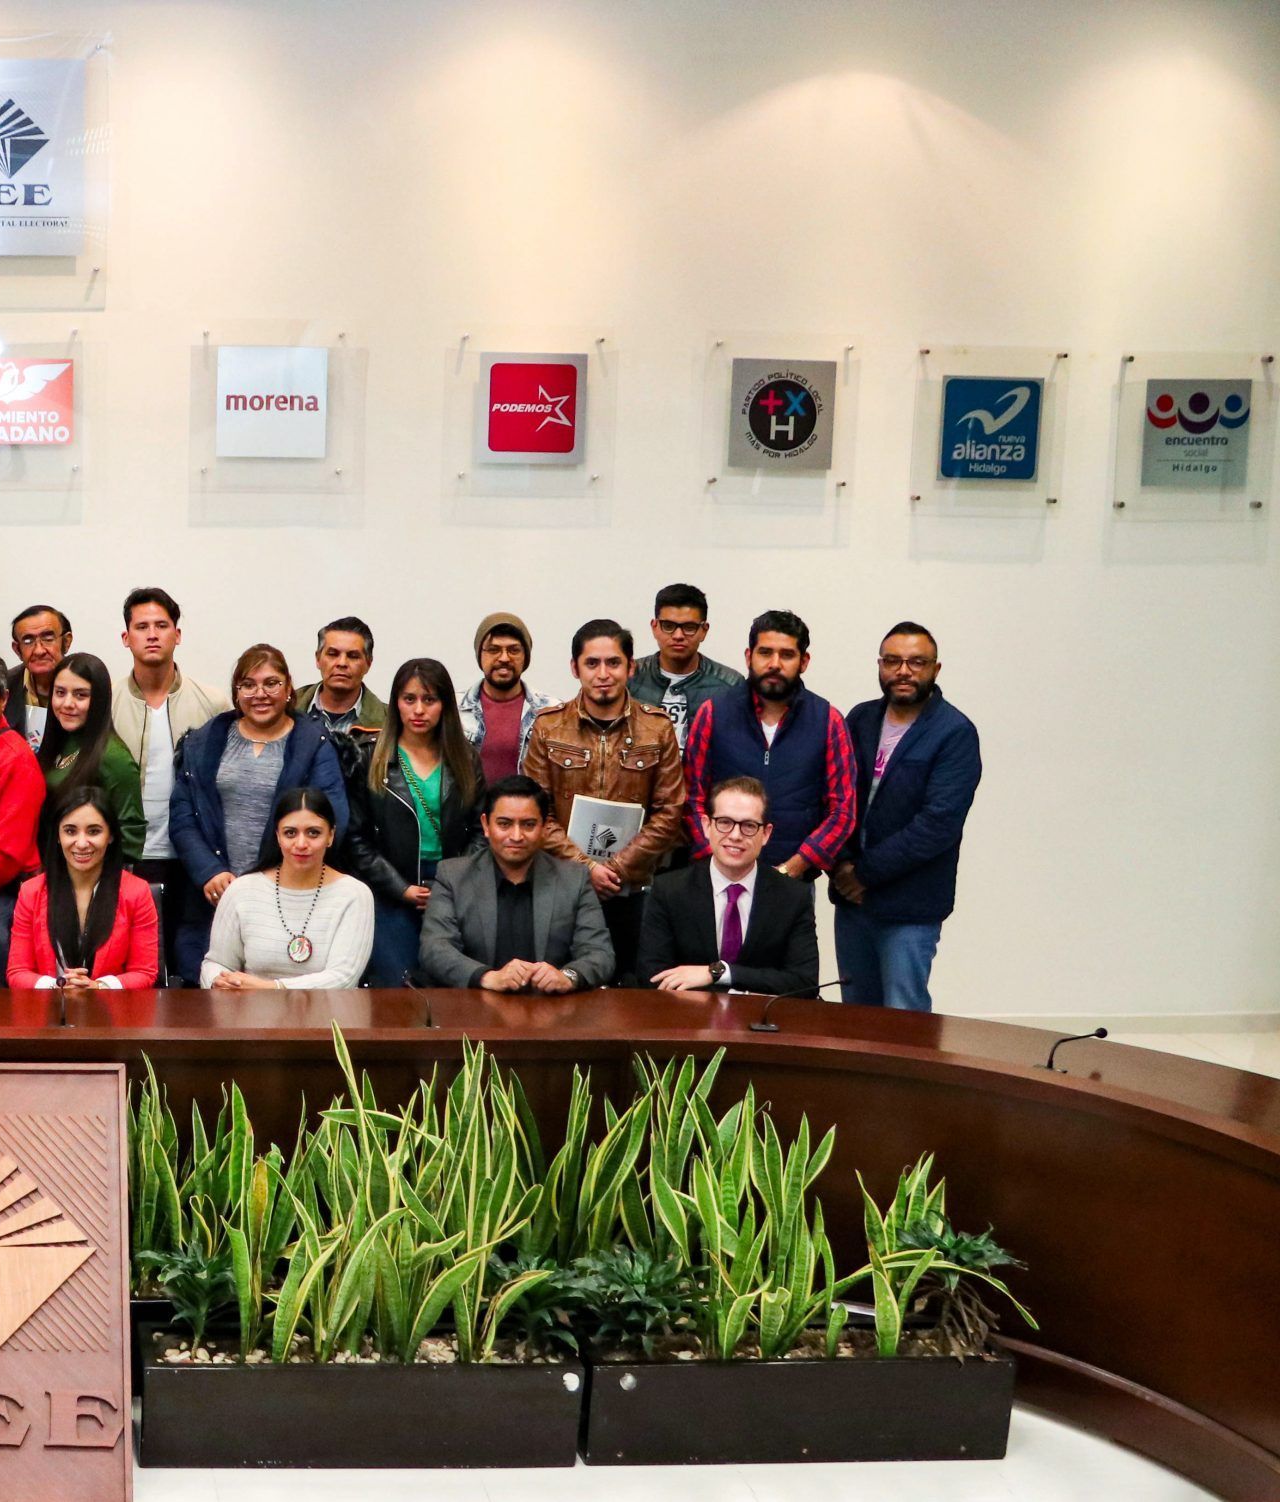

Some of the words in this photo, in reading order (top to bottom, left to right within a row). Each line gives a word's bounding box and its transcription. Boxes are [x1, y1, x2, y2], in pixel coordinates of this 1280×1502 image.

[225, 393, 319, 412] morena
[741, 378, 766, 416] PARTIDO
[808, 384, 824, 415] LOCAL
[491, 403, 553, 414] PODEMOS
[998, 435, 1026, 443] nueva
[1164, 436, 1229, 446] encuentro
[762, 448, 781, 459] POR
[784, 433, 818, 459] HIDALGO
[952, 439, 1026, 461] alianza
[968, 463, 1007, 476] Hidalgo
[1172, 463, 1218, 474] Hidalgo
